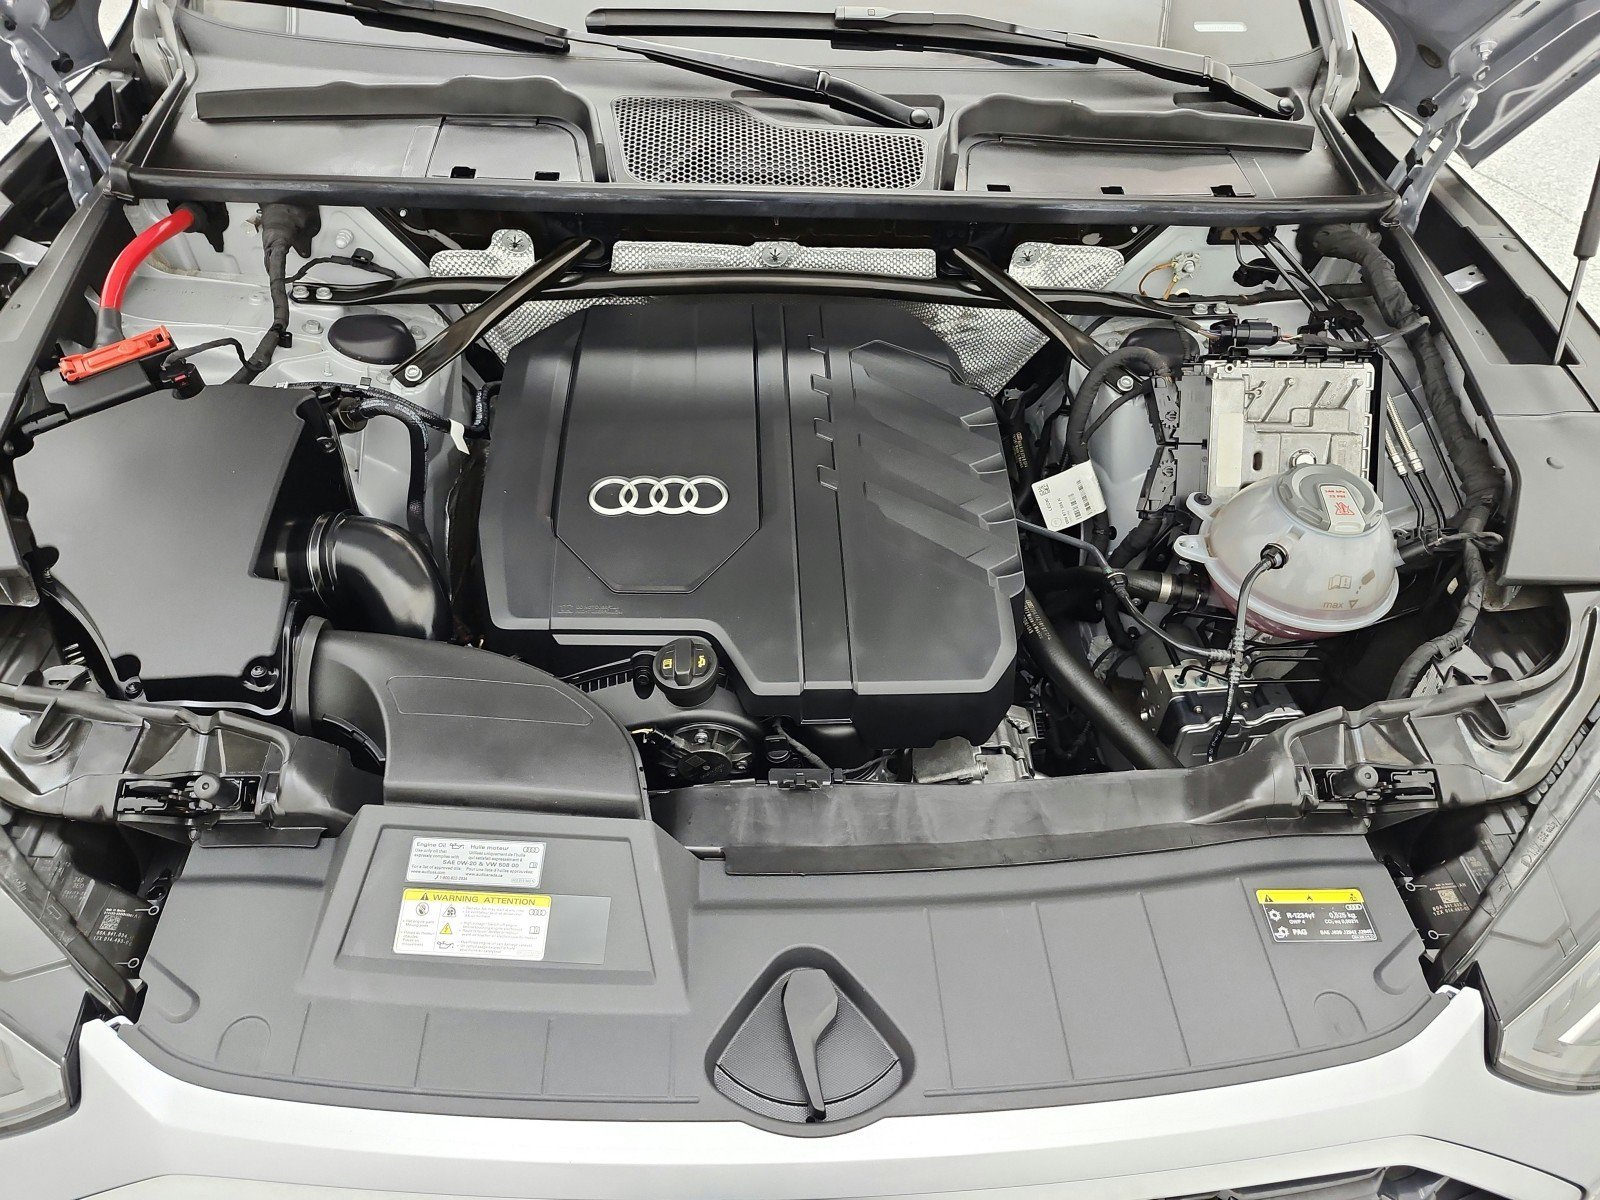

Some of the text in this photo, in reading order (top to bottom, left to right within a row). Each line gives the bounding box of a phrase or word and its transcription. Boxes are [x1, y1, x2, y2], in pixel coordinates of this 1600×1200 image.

[1323, 601, 1344, 609] max
[432, 894, 535, 905] WARNING ATTENTION
[1286, 912, 1315, 920] R-1234yf
[1291, 928, 1308, 936] PAG
